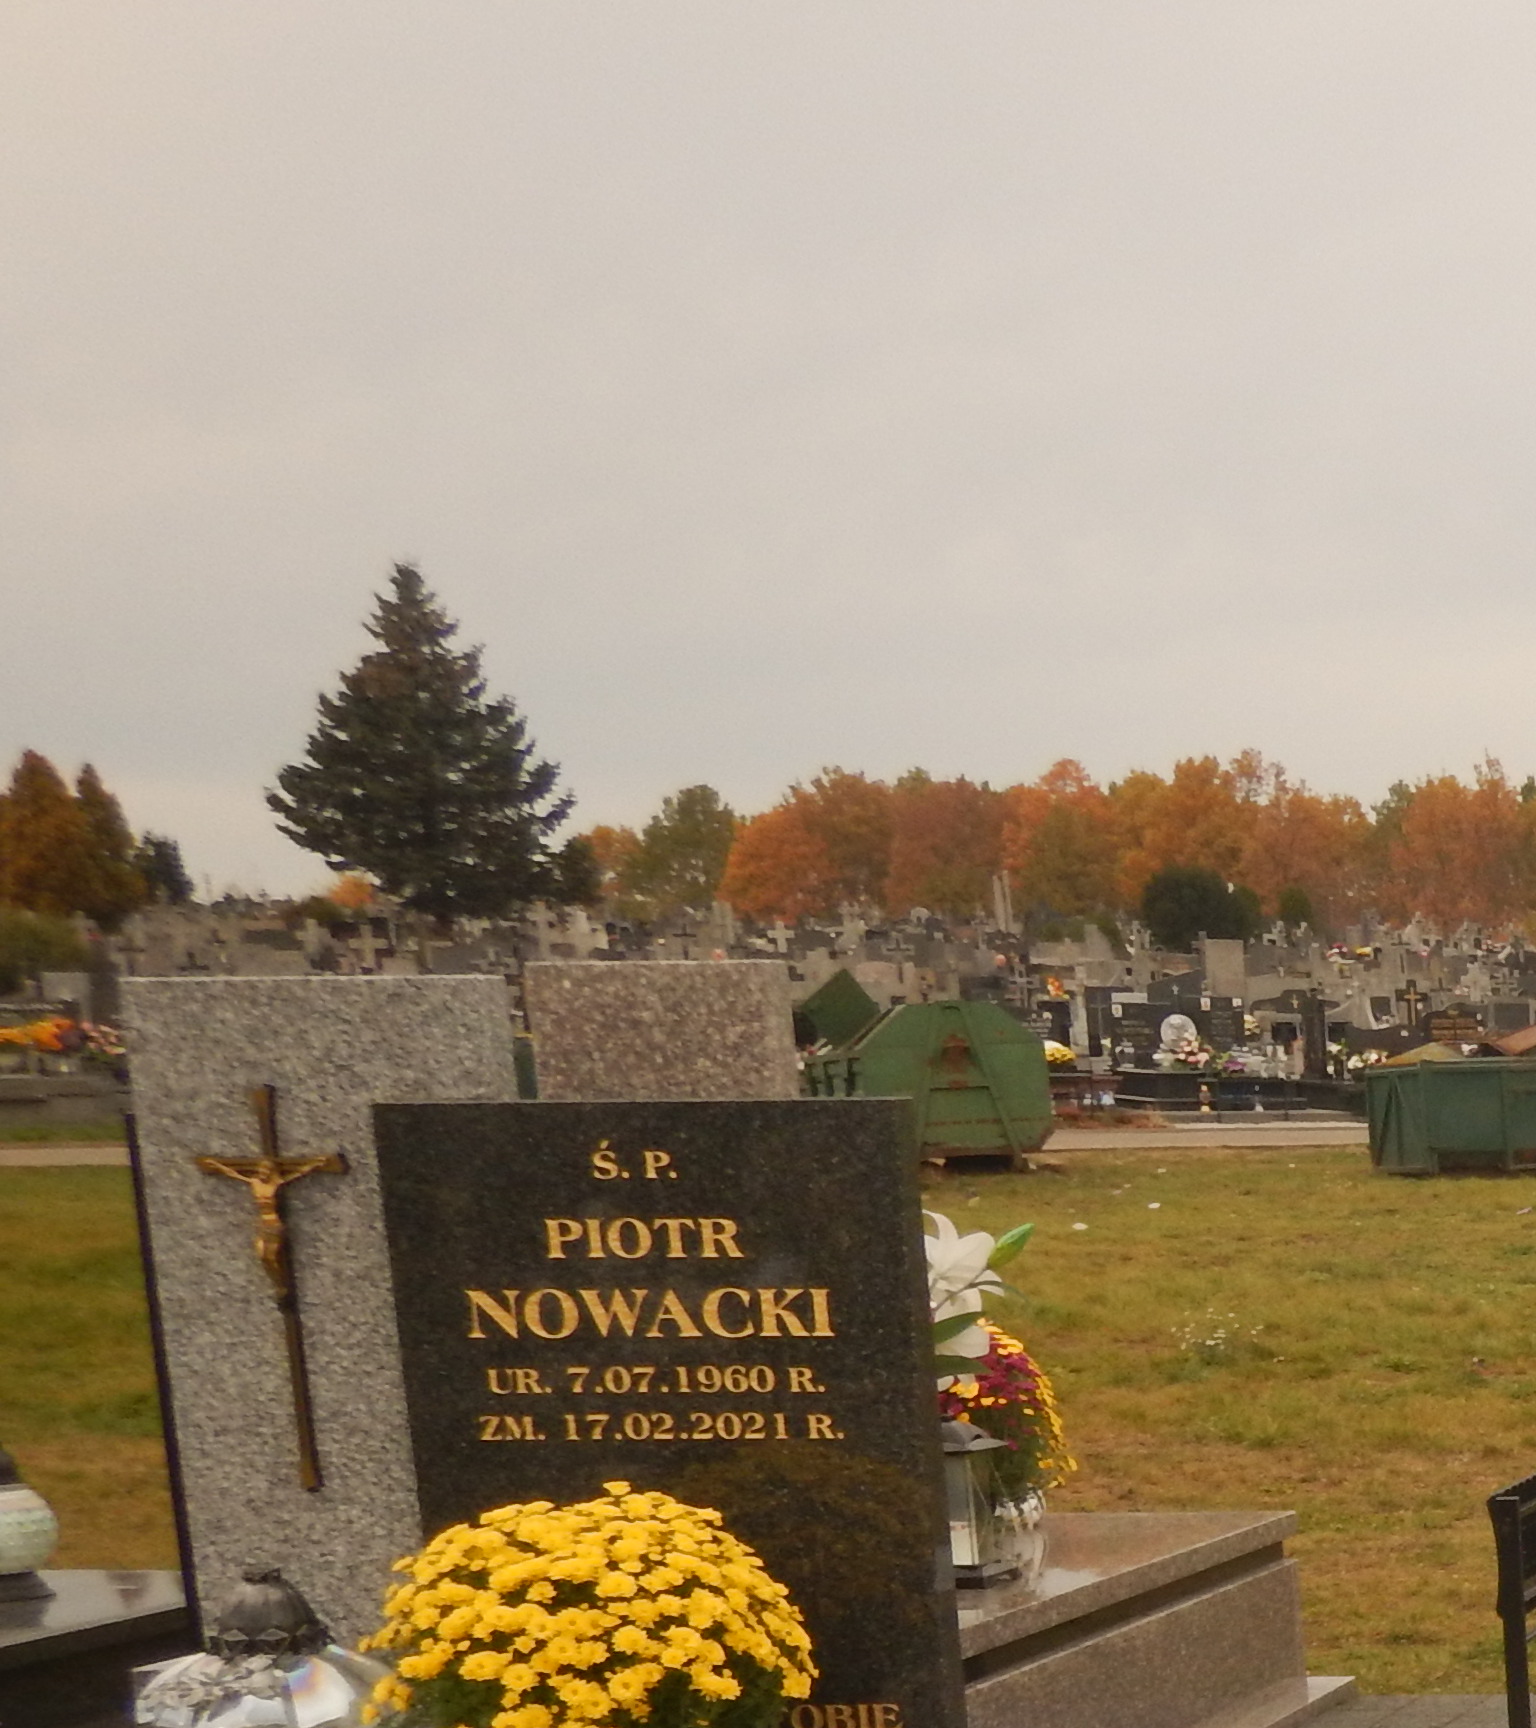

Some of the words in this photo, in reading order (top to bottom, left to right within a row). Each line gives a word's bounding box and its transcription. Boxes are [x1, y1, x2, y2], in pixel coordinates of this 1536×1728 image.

[593, 1141, 630, 1181] Ś.
[644, 1151, 678, 1181] P.
[545, 1217, 744, 1260] PIOTR
[465, 1287, 836, 1340] NOWACKI
[487, 1368, 553, 1395] UR.
[567, 1364, 776, 1395] 7.07.1960
[790, 1368, 826, 1394] R.
[479, 1415, 547, 1442] ZM.
[562, 1411, 789, 1442] 17.02.2021
[807, 1415, 846, 1441] R.
